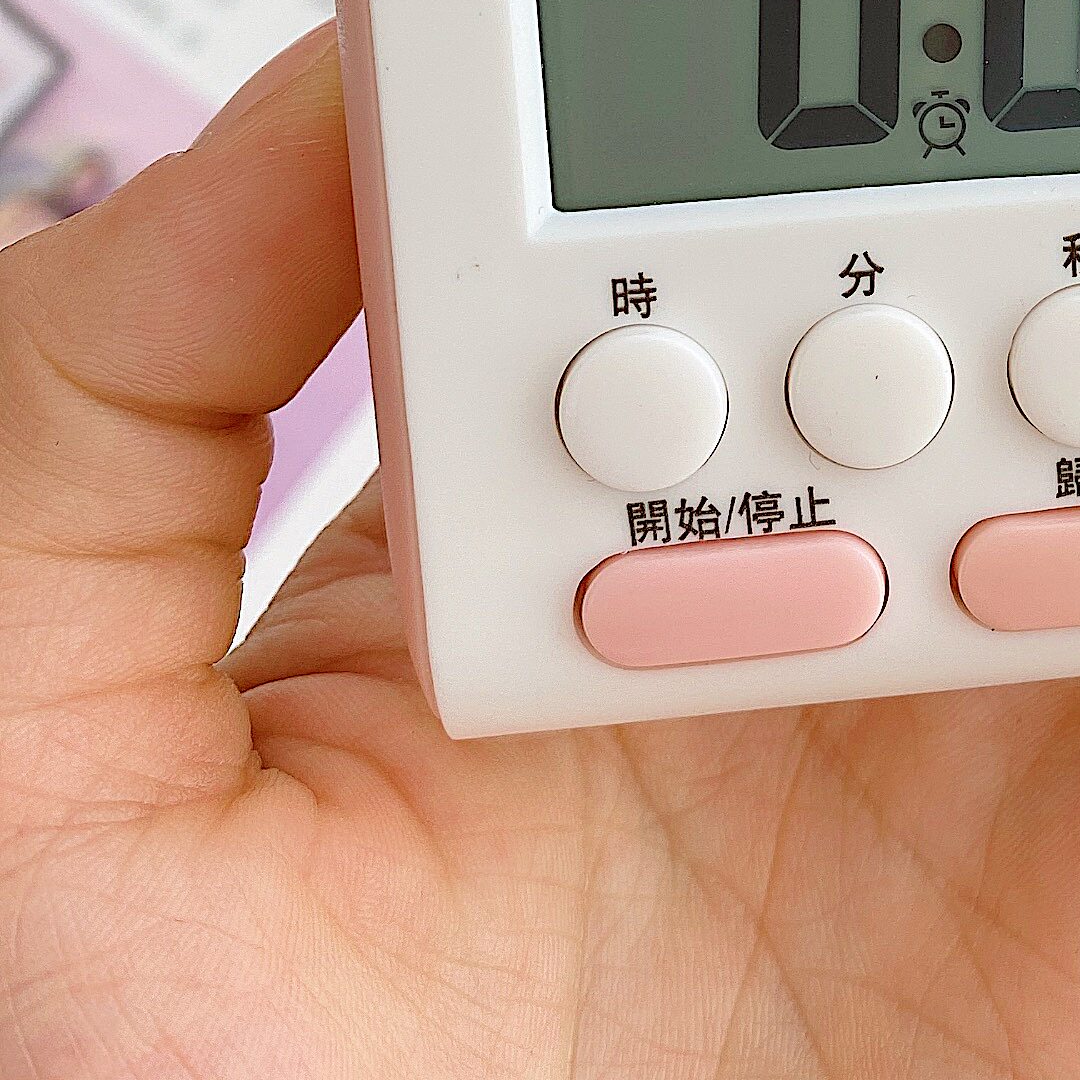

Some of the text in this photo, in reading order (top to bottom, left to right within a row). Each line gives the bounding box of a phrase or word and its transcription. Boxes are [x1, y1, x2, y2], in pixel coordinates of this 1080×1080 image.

[611, 271, 657, 318] 時
[838, 251, 885, 298] 分
[627, 485, 837, 546] 開始/停止
